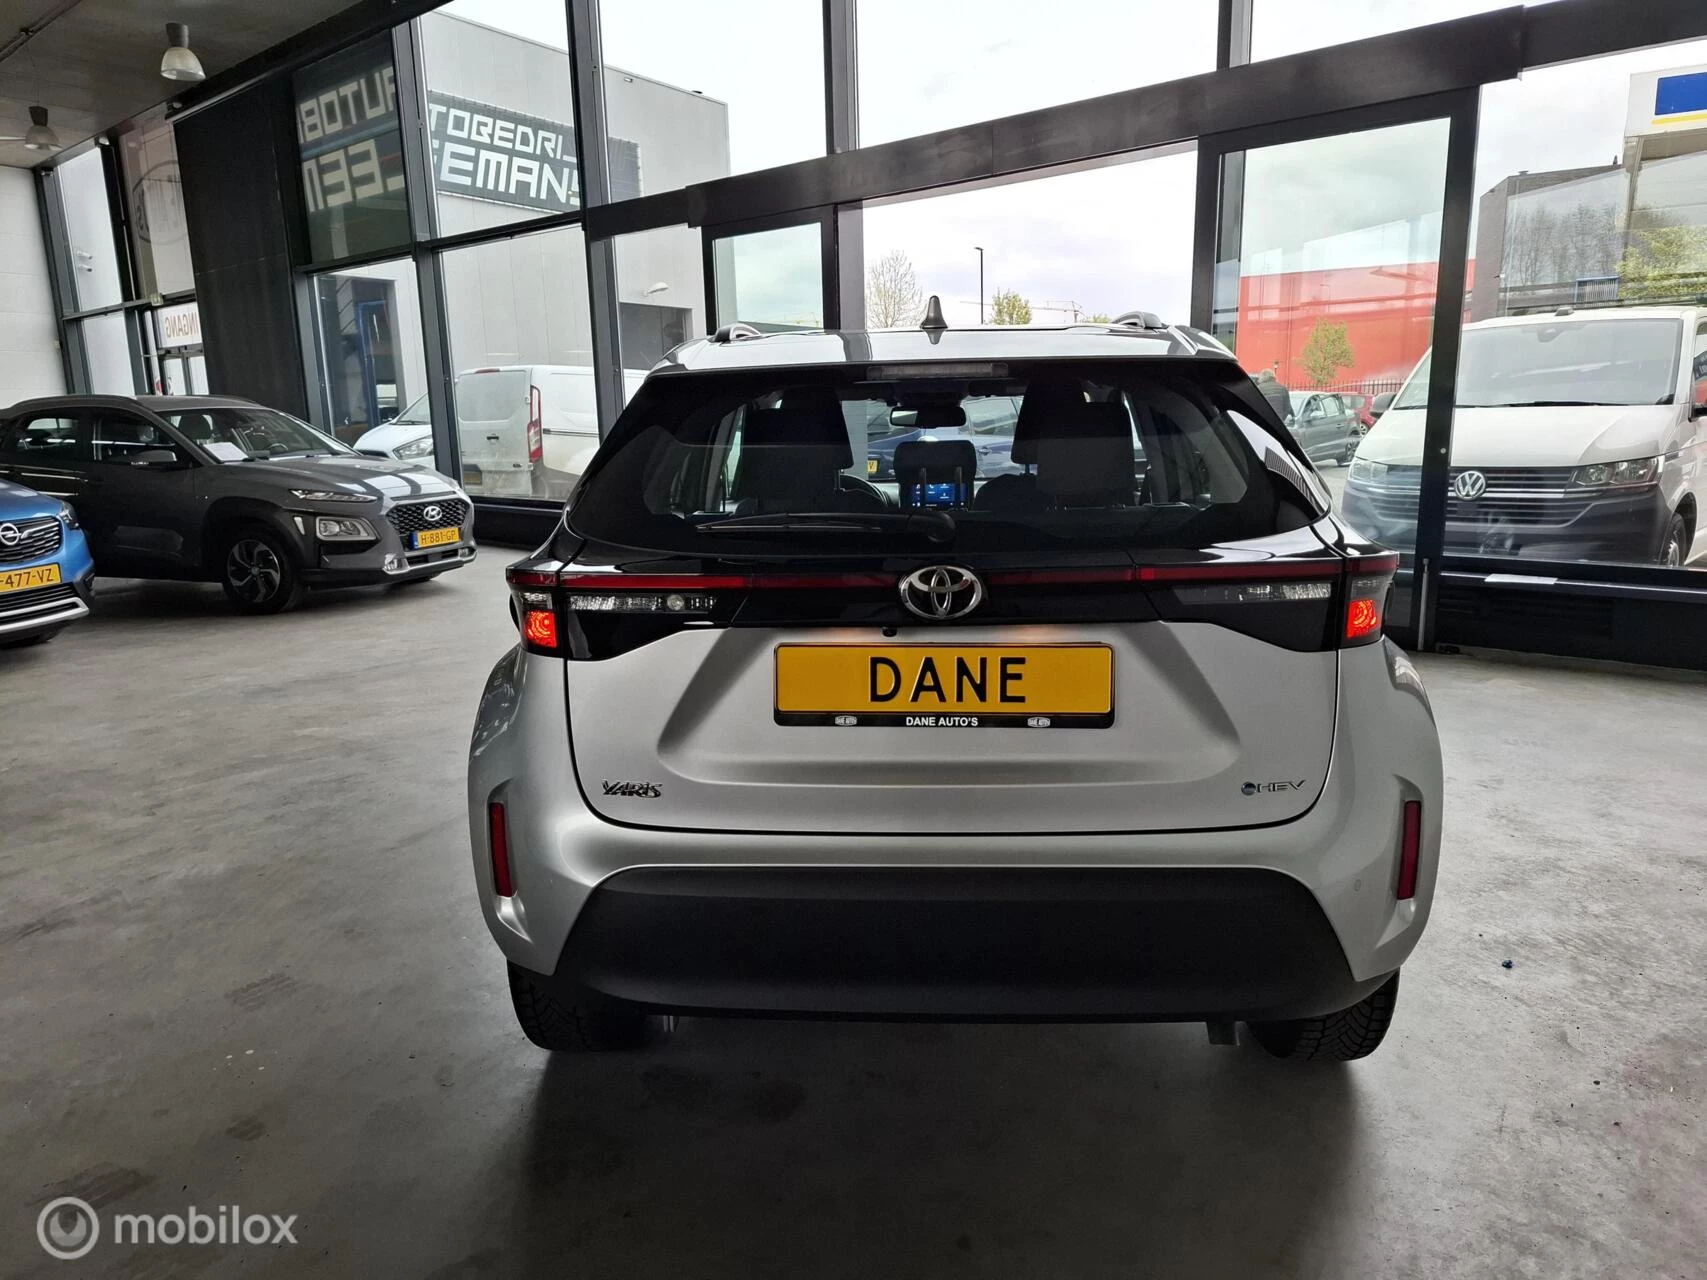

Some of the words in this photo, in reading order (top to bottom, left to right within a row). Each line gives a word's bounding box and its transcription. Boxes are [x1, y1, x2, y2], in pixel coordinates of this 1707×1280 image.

[420, 530, 456, 545] H-881-GP
[869, 657, 1026, 703] DANE
[906, 717, 936, 726] DANE
[938, 717, 979, 727] AUTO'S
[601, 780, 663, 798] YARIS
[1257, 780, 1306, 793] HEV
